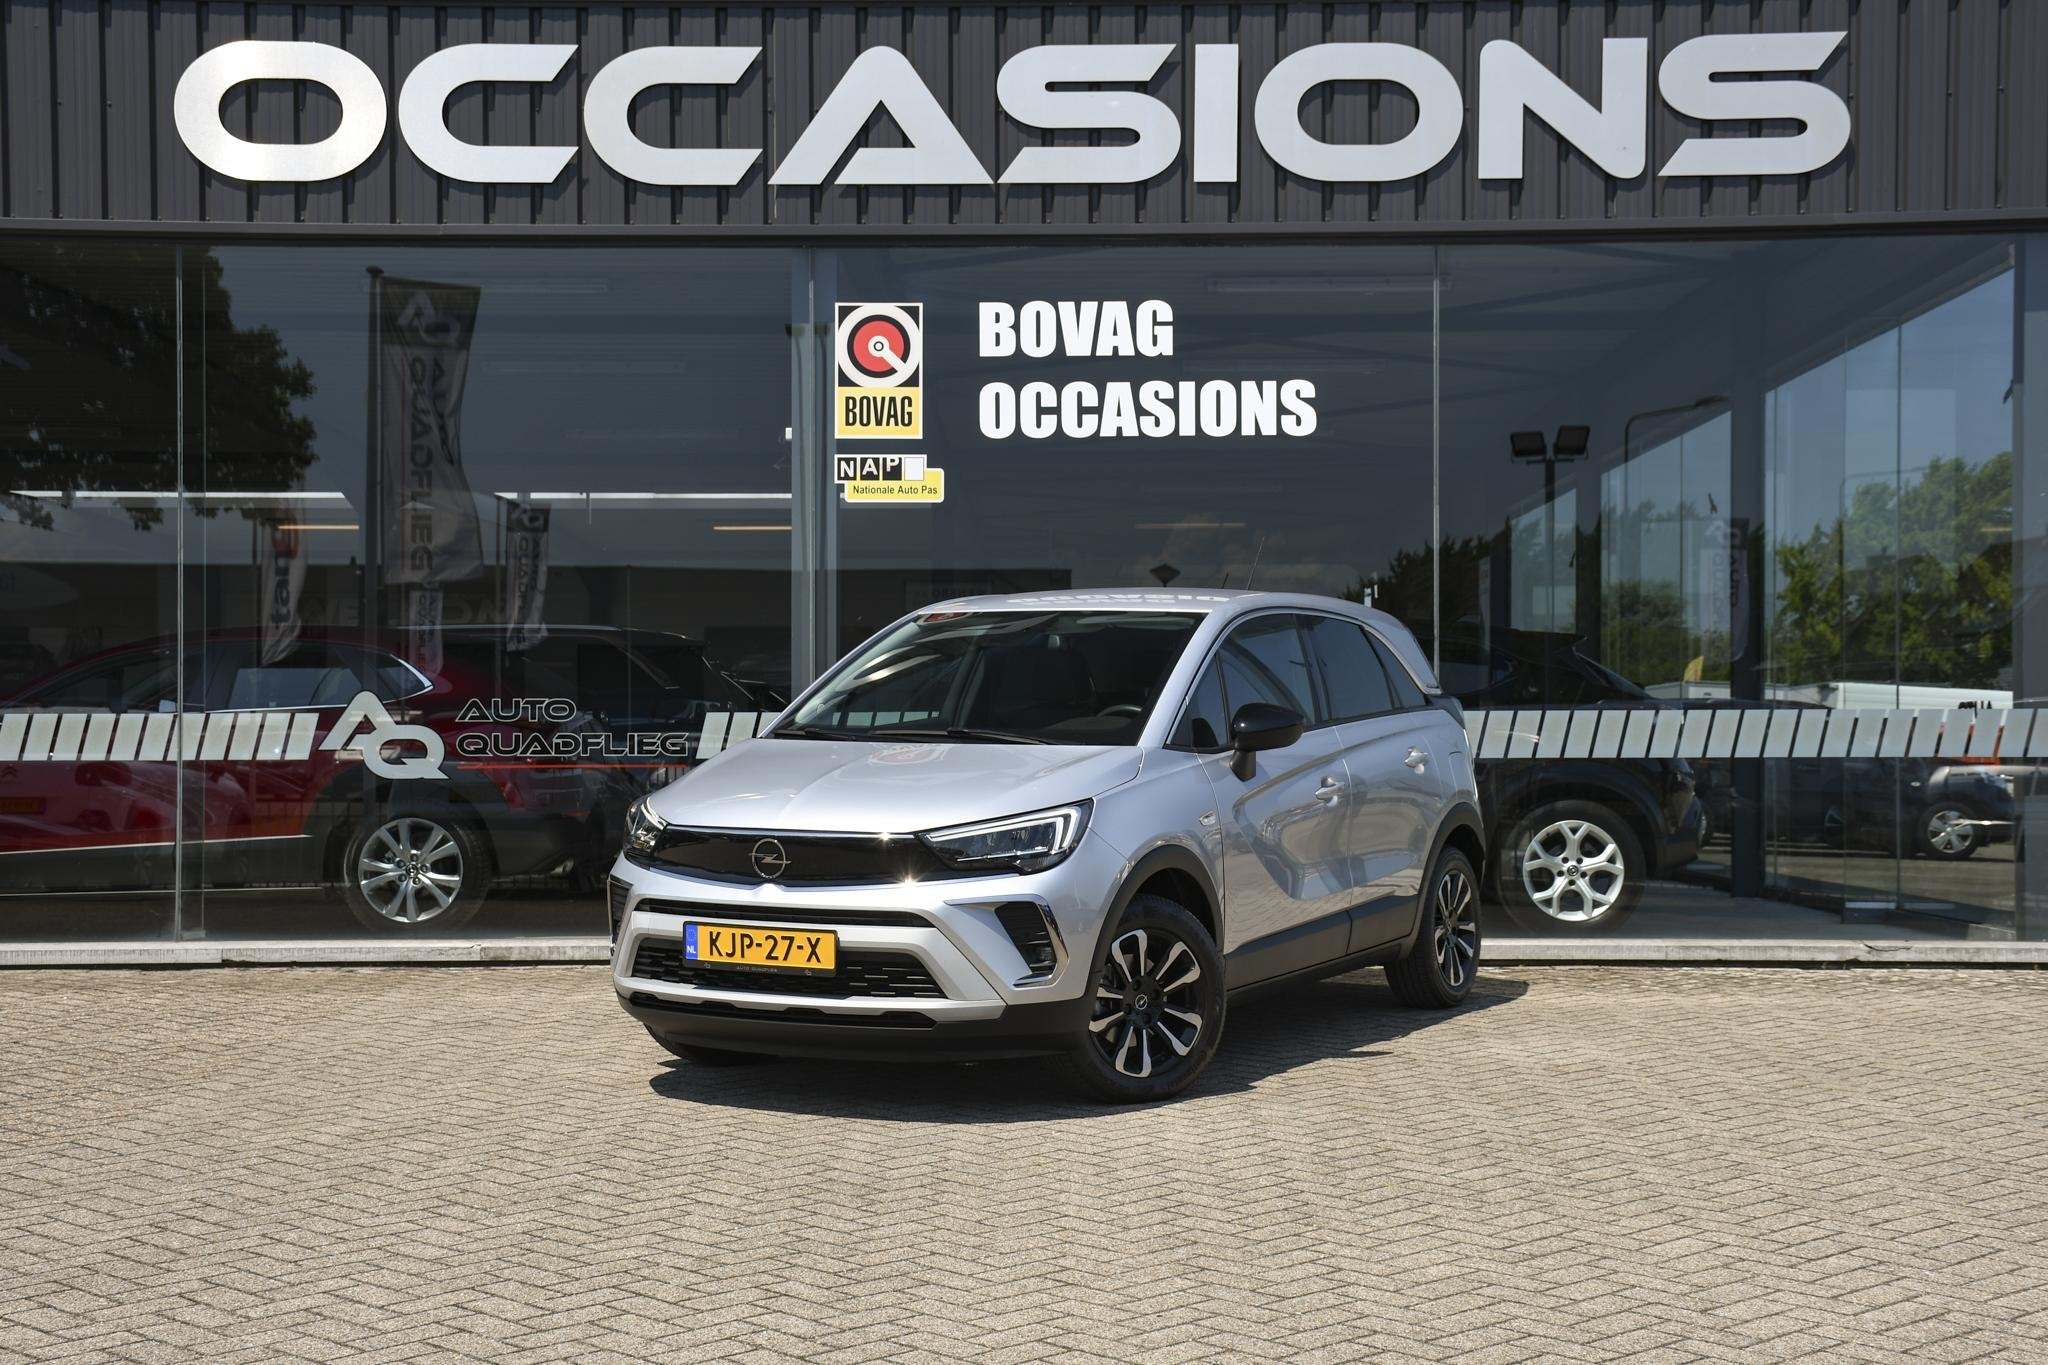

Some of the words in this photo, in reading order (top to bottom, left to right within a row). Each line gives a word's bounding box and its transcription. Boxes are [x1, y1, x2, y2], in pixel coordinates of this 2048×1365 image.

[174, 31, 1851, 186] OCCASIONS
[979, 300, 1173, 357] BOVAG
[845, 396, 913, 427] BOVAG
[980, 380, 1316, 438] OCCASIONS
[839, 457, 900, 478] NAP
[853, 485, 895, 495] Nationale
[897, 485, 919, 495] Auto
[921, 485, 938, 495] Pas
[456, 698, 577, 722] AUTO
[456, 732, 689, 757] QUADFLIEG
[686, 945, 697, 954] NL
[709, 931, 821, 963] KJP-27-X
